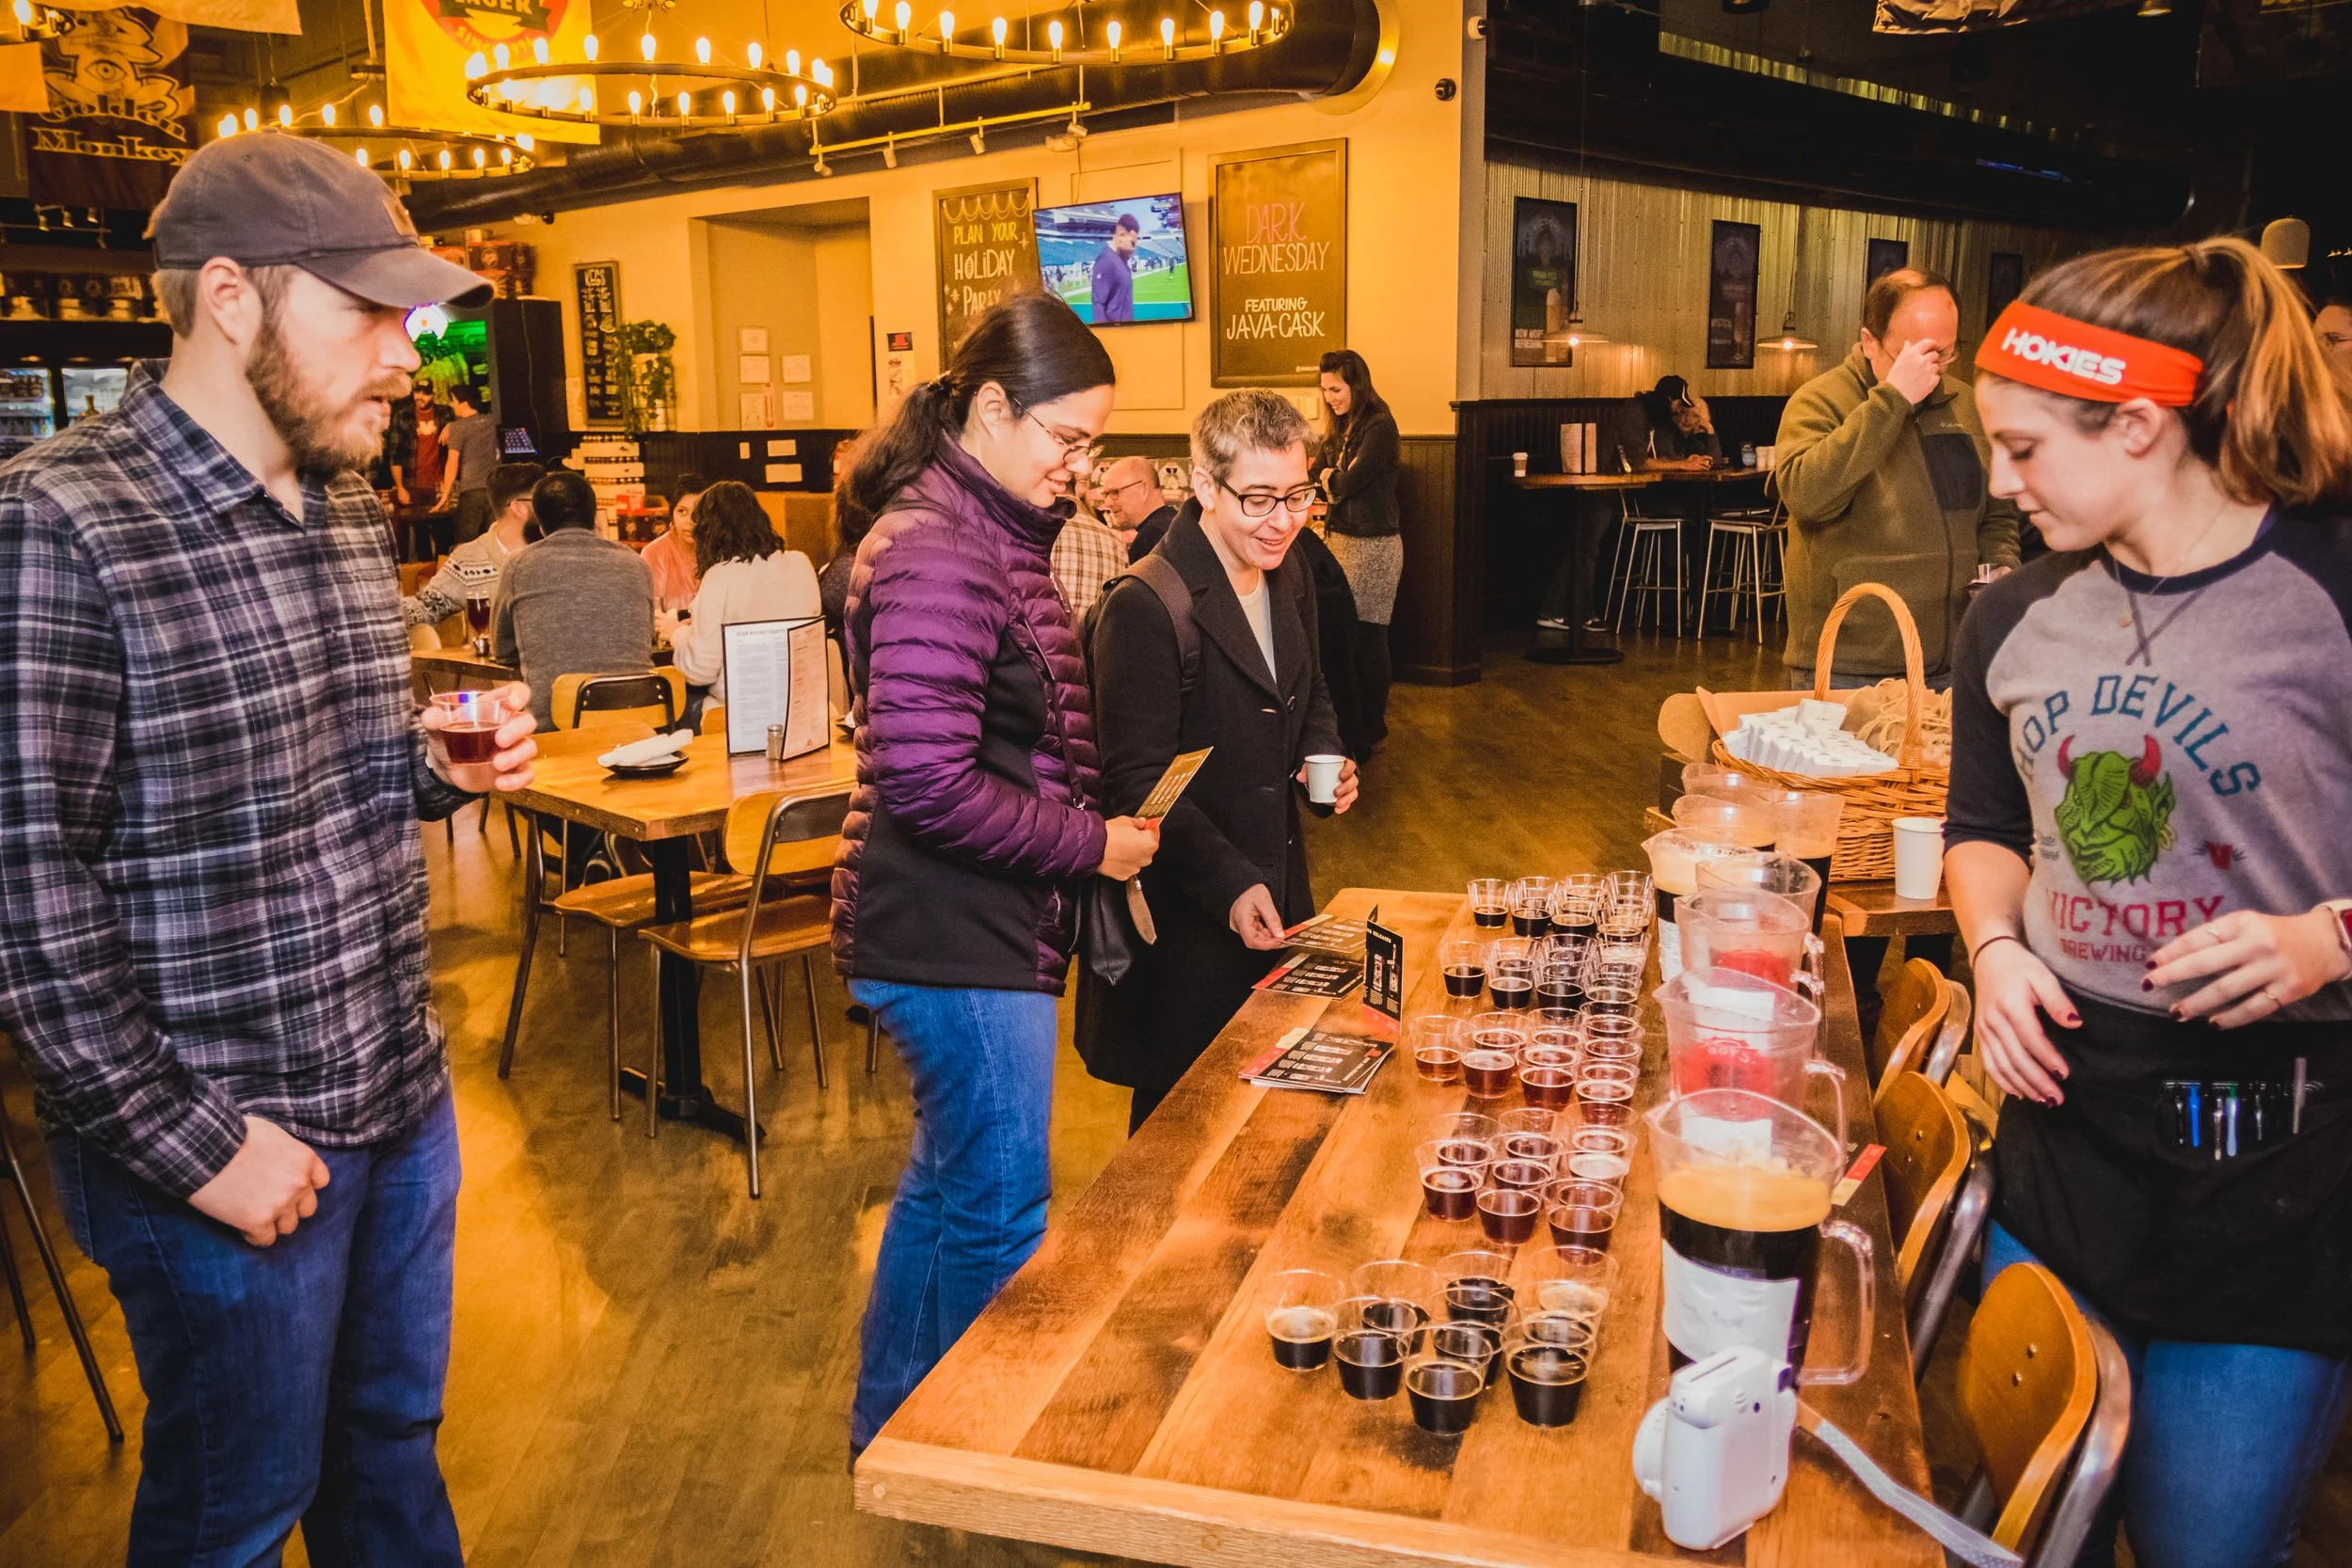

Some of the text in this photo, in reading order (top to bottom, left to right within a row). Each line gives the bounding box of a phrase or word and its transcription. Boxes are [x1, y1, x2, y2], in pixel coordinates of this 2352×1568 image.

[27, 126, 198, 166] Monkey
[953, 221, 1019, 245] PLAN YOUR
[1246, 202, 1308, 245] DARK
[1224, 242, 1330, 275] WEDNESDAY
[1245, 296, 1308, 313] FEATURING
[1279, 311, 1326, 339] CASK
[2001, 327, 2126, 385] HOKIES
[2090, 674, 2262, 797] DEVILS
